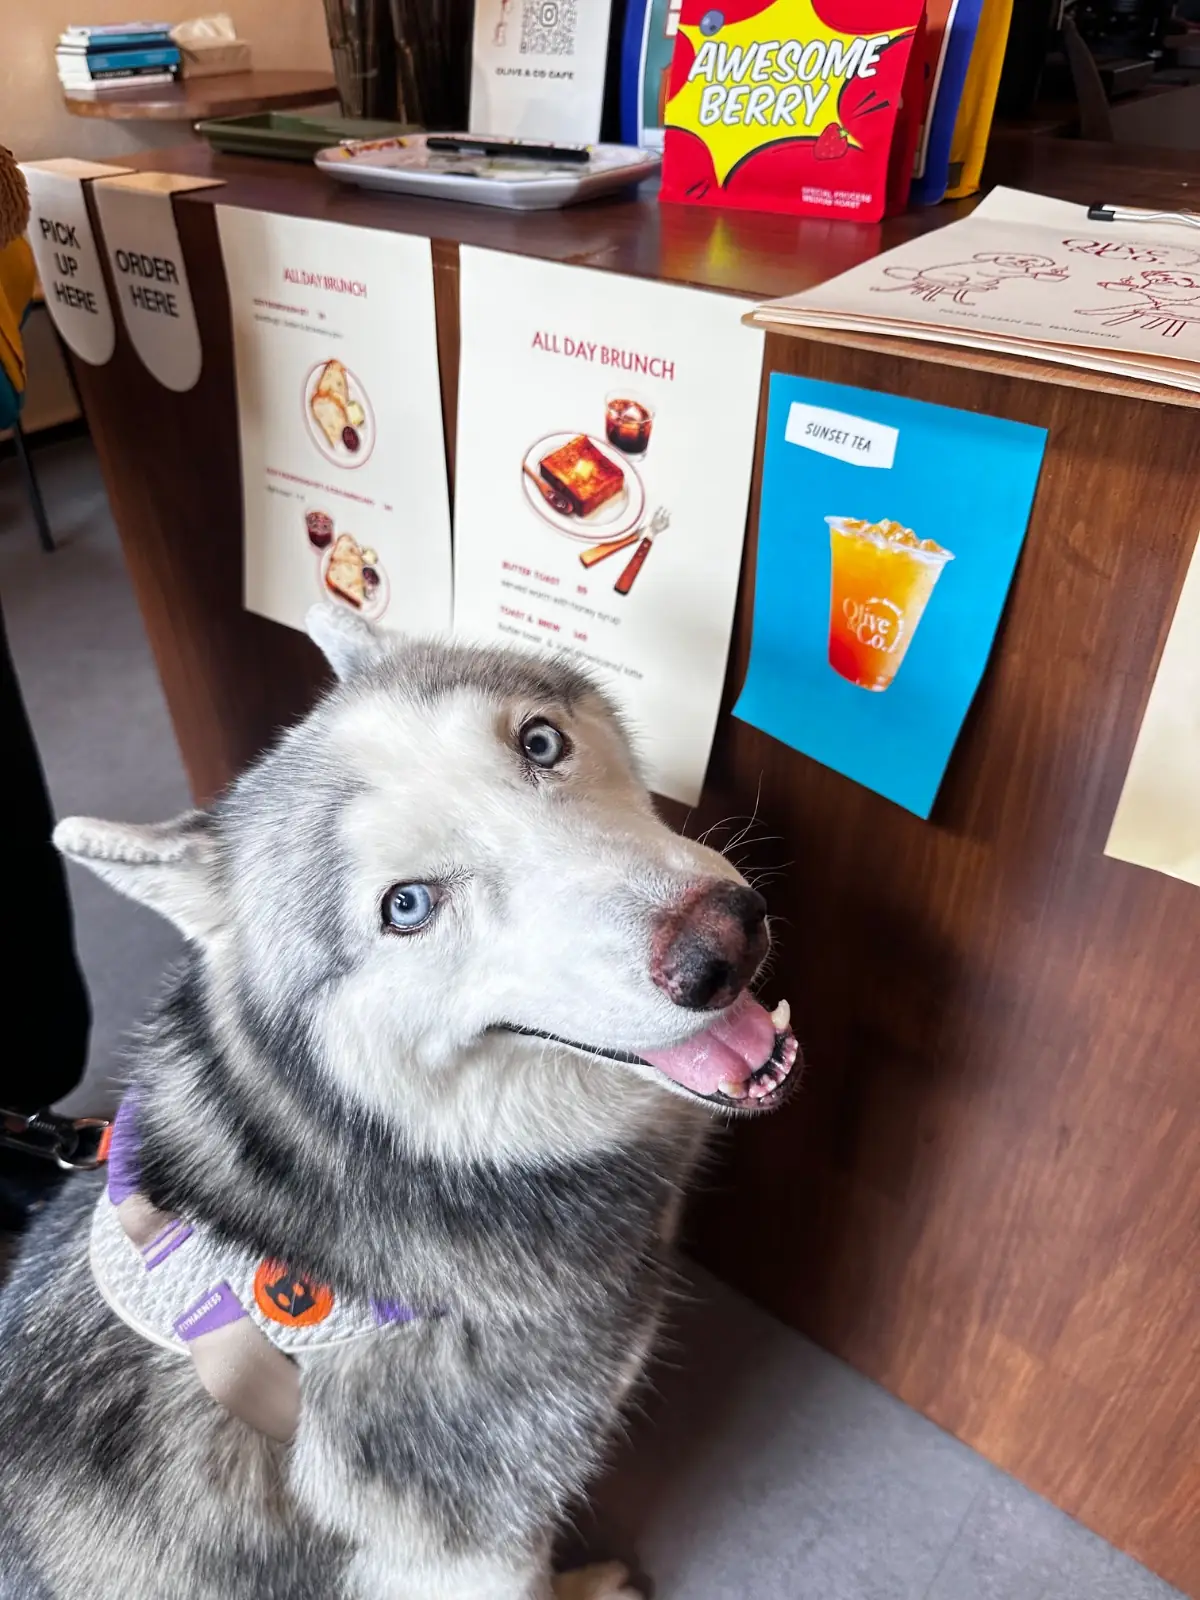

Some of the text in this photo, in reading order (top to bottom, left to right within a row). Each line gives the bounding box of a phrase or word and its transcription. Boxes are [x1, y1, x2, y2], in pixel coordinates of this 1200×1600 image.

[495, 67, 522, 77] OLIVE
[687, 34, 891, 83] AWESOME
[698, 83, 831, 127] BERRY
[39, 218, 81, 249] PICK
[54, 252, 78, 278] UP
[115, 249, 180, 285] ORDER
[54, 281, 98, 315] HERE
[283, 267, 367, 298] ALL DAY BRUNCH
[129, 284, 180, 318] HERE
[531, 331, 675, 381] ALL DAY BRUNCH
[805, 422, 872, 452] SUNSET TEA
[501, 561, 532, 577] BUTTER
[534, 571, 560, 585] TOAST
[842, 597, 891, 634] Olive
